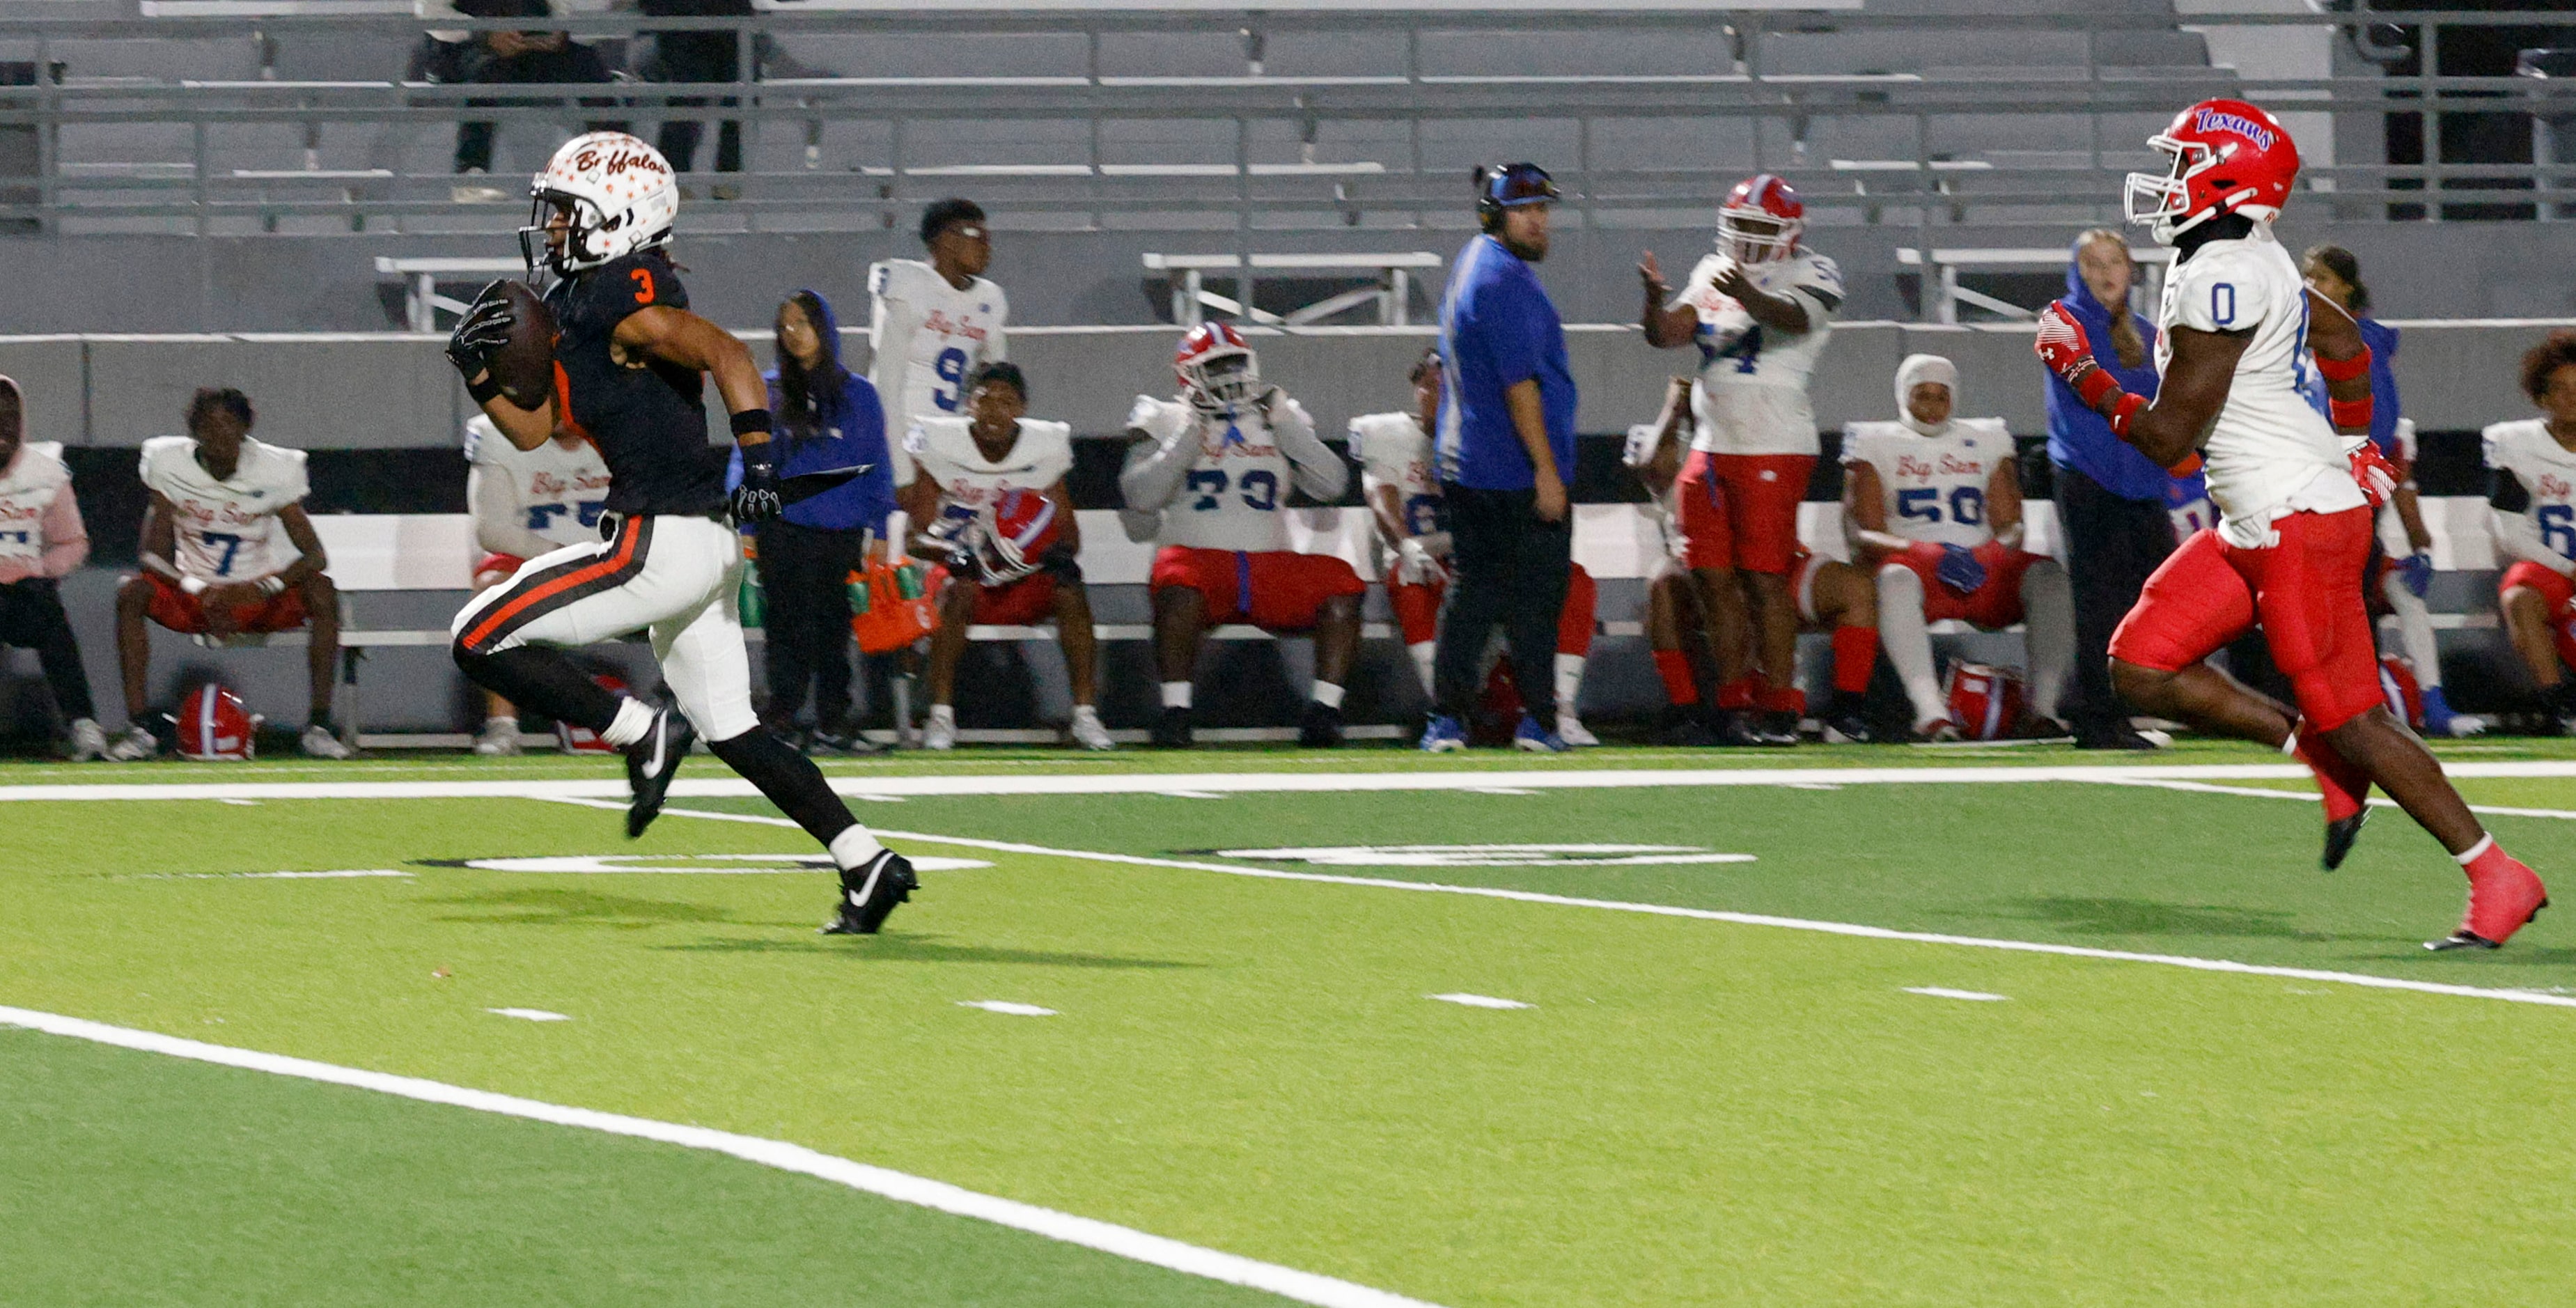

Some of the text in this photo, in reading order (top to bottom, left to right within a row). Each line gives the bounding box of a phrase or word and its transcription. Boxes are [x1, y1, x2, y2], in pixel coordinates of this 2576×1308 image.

[2195, 107, 2270, 153] Texans
[631, 268, 655, 303] 3
[2212, 282, 2235, 325] 0
[932, 347, 966, 412] 9
[1896, 453, 1983, 485] Big Sam
[1898, 485, 1984, 525] 50
[202, 531, 241, 576] 7
